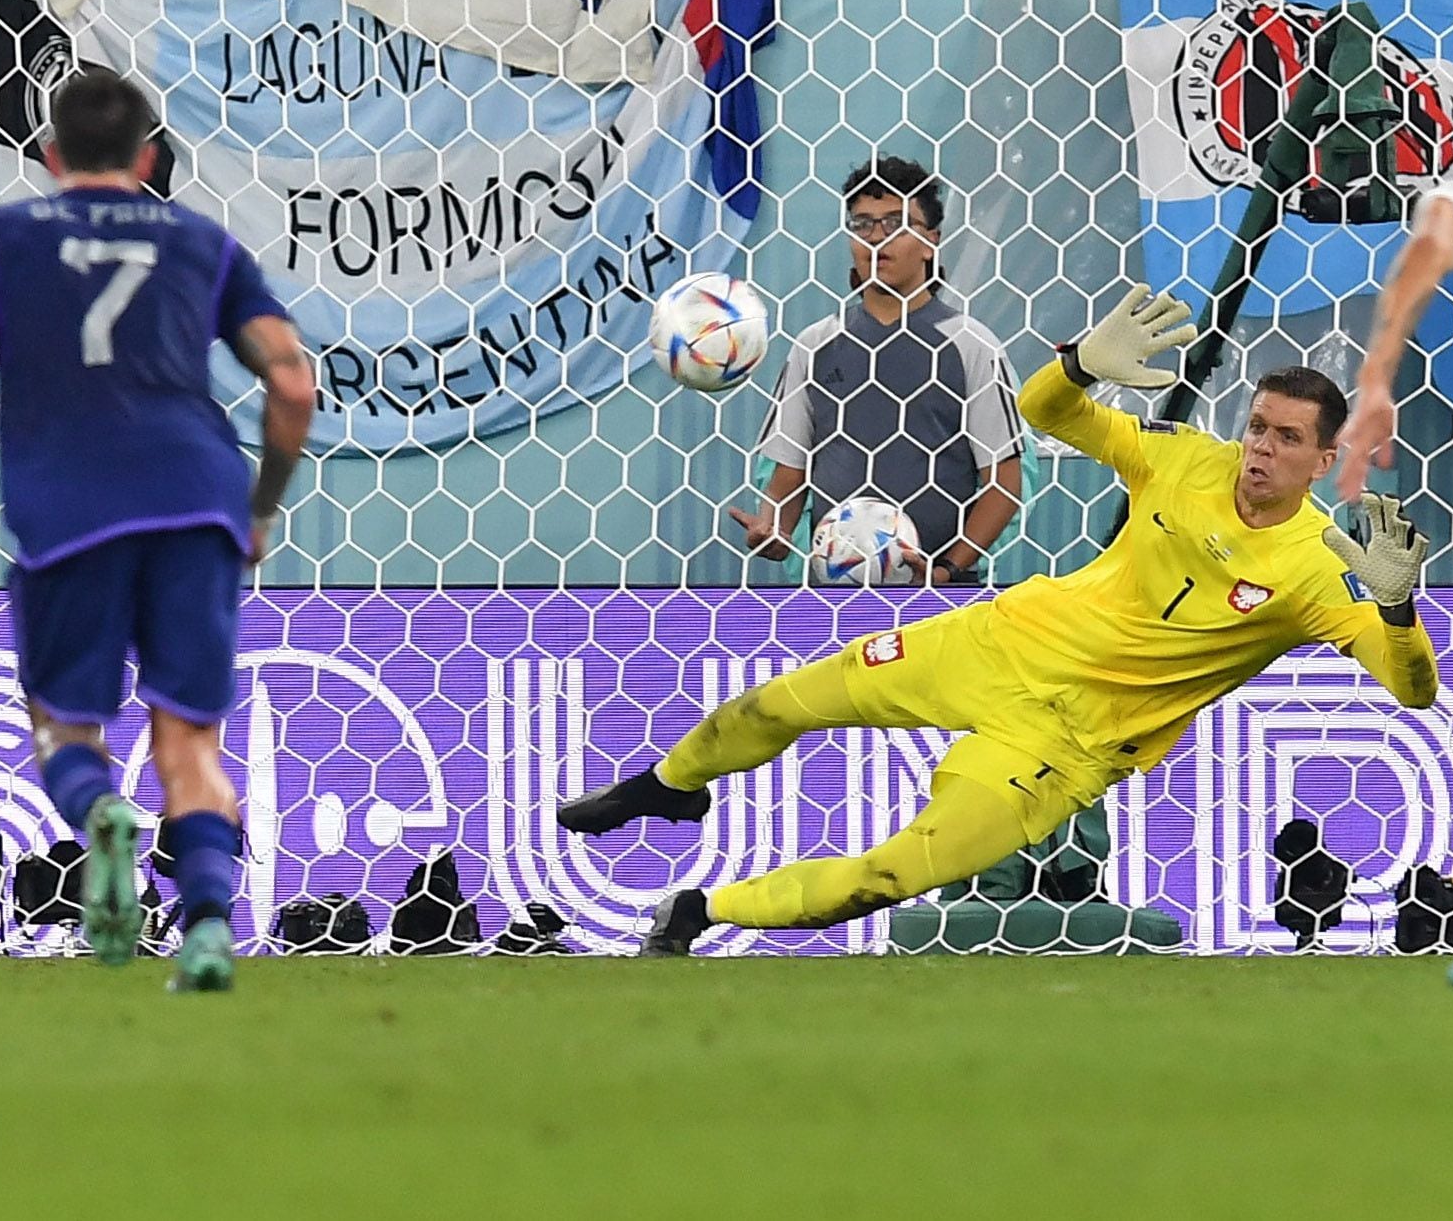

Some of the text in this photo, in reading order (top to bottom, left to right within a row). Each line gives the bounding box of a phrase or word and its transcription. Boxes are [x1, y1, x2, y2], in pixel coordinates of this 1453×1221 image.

[221, 18, 447, 105] LAGUNA
[58, 236, 159, 368] 7
[311, 212, 676, 420] RGENTINA
[1161, 575, 1195, 622] 1
